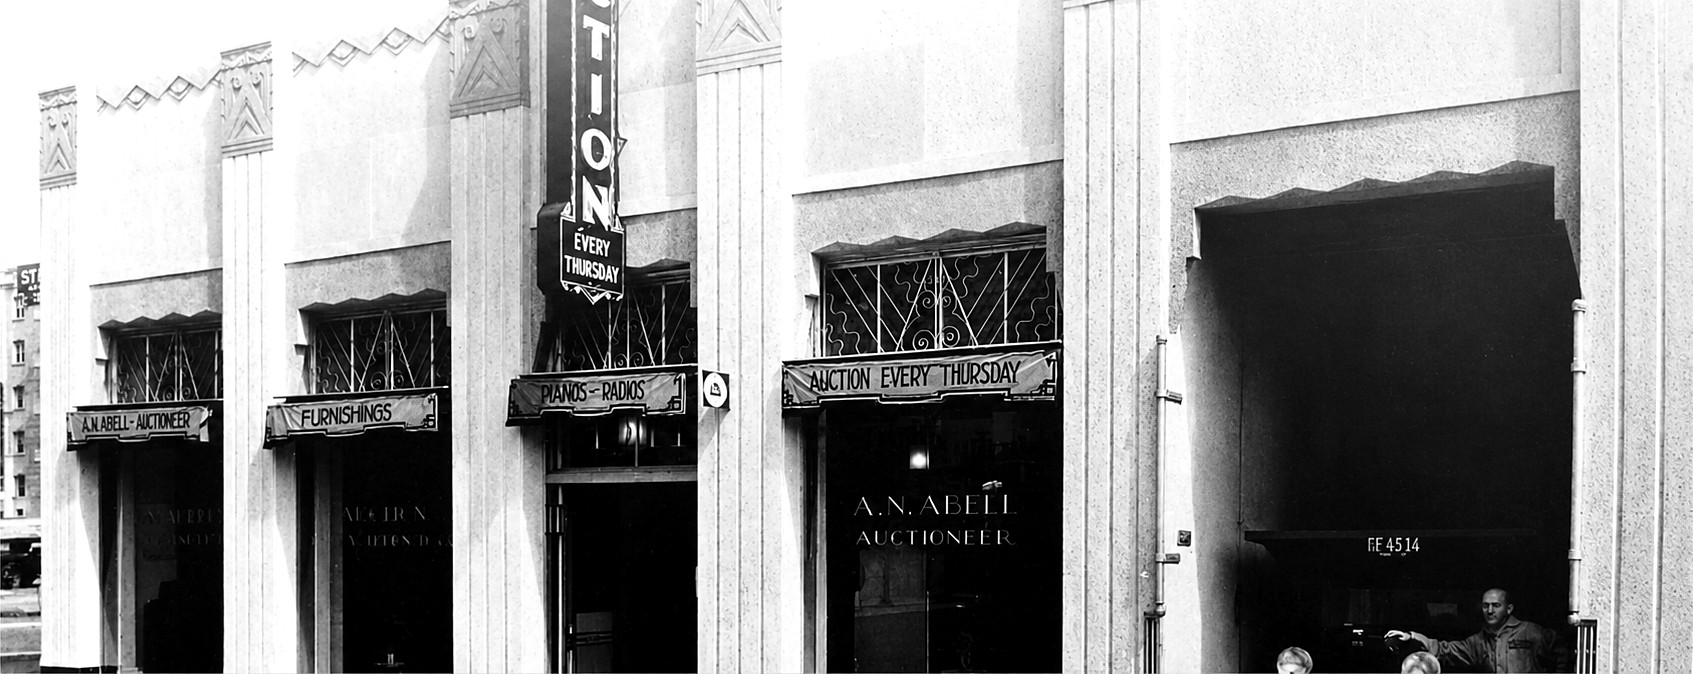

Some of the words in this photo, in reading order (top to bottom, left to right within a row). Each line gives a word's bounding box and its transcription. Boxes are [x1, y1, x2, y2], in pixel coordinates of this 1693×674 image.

[580, 0, 612, 231] TION
[574, 232, 611, 257] EVERY
[564, 254, 620, 284] THURSDAY
[810, 367, 871, 392] AUCTION
[881, 365, 931, 389] EVERY
[942, 361, 1021, 386] THURSDAY
[541, 382, 588, 404] PIANOS
[602, 380, 646, 401] RADIOS
[136, 411, 191, 430] AUCTIONEER
[301, 403, 392, 427] FURNISHINGS
[919, 494, 1017, 516] ABELL
[855, 530, 1017, 546] AUCTIONEER
